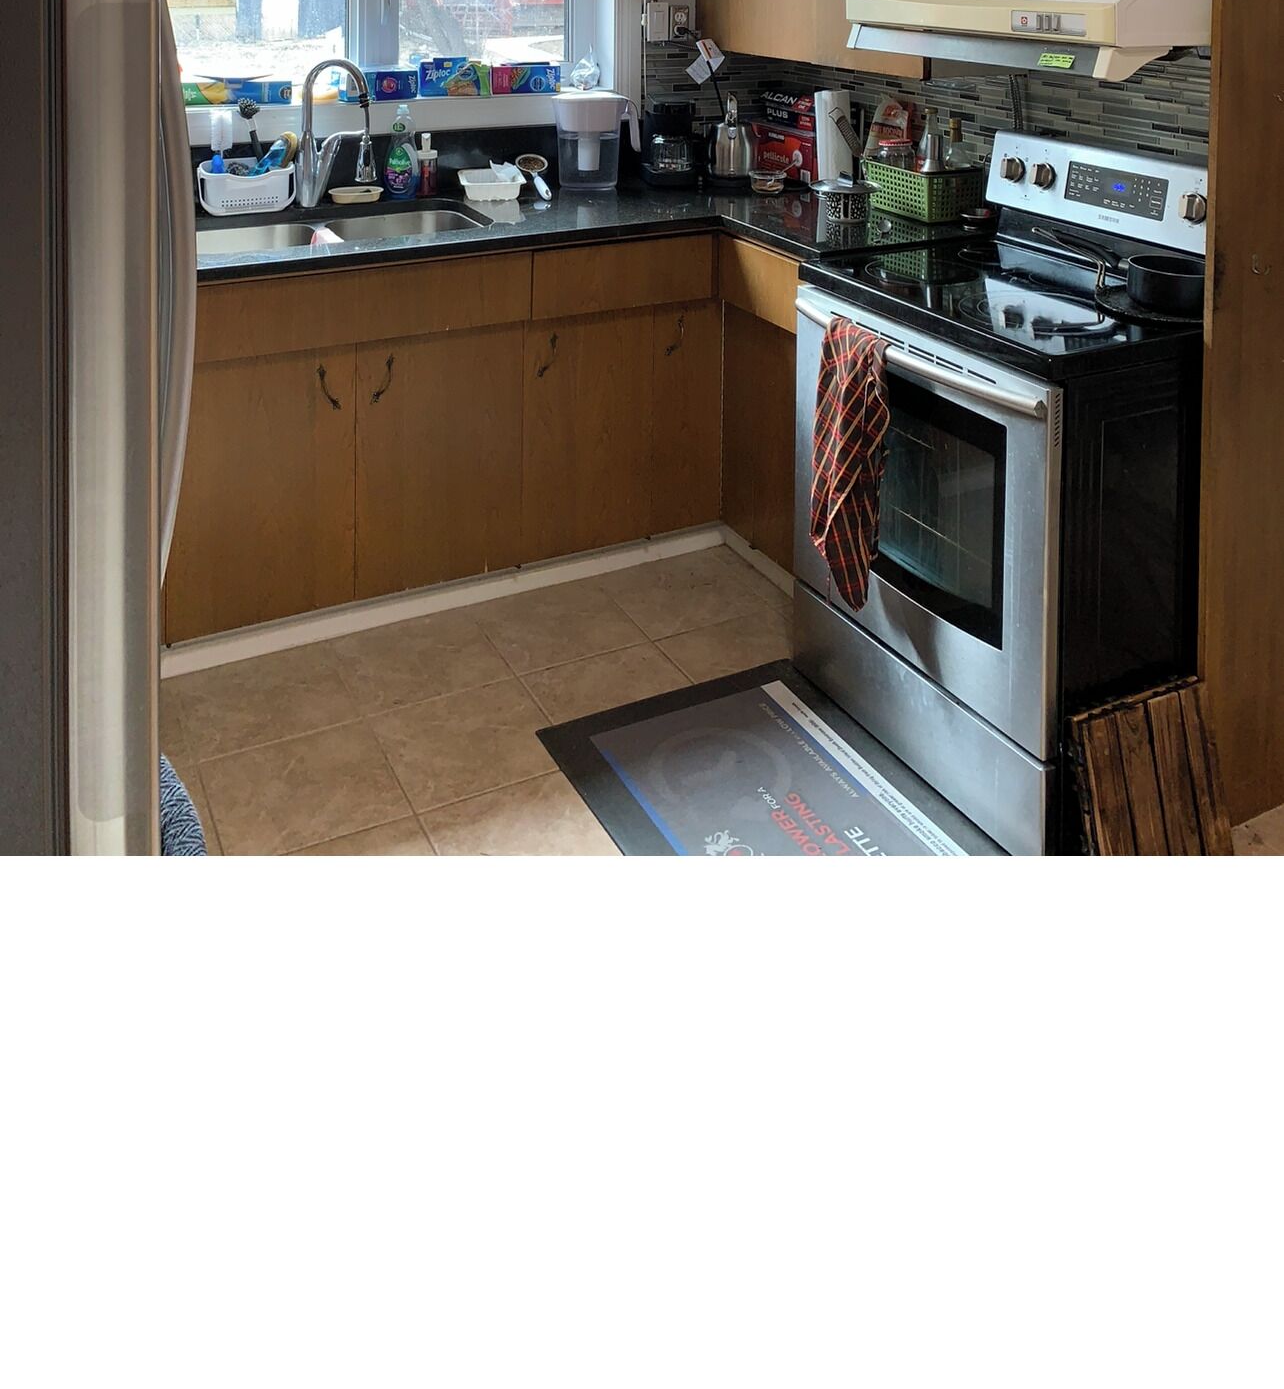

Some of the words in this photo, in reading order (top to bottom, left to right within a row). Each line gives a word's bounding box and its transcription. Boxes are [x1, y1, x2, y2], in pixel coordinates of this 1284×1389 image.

[425, 69, 451, 83] Ziploc
[546, 67, 556, 90] Ziploc
[760, 91, 798, 105] ALCAN
[767, 108, 789, 119] PLUS
[762, 793, 781, 811] FOR
[770, 810, 826, 856] OWER
[783, 791, 851, 856] LASTING
[844, 826, 888, 856] TTE
